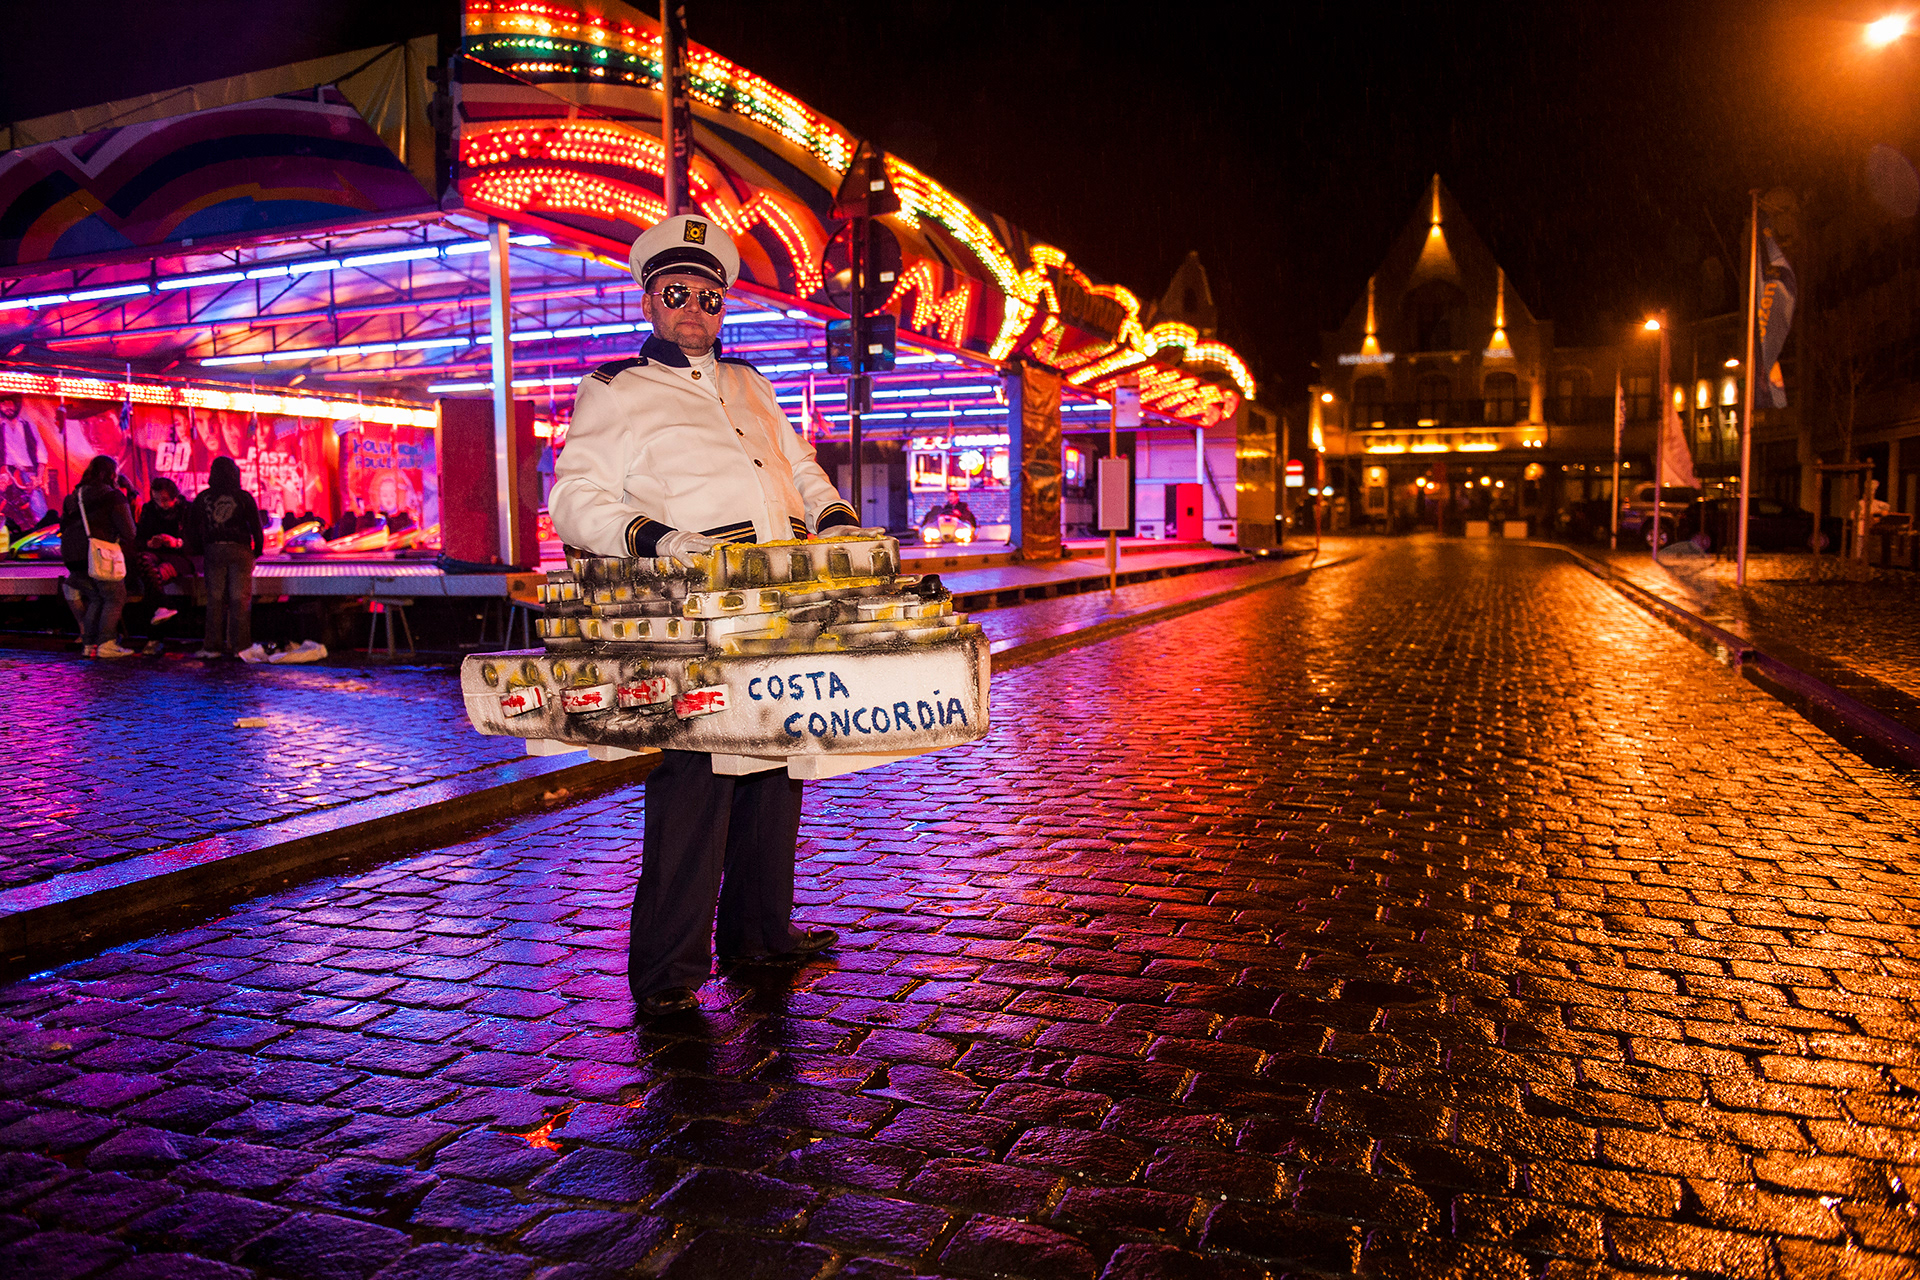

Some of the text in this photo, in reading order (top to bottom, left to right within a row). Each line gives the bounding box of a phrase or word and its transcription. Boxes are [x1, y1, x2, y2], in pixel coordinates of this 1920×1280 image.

[155, 441, 192, 472] 60
[247, 446, 288, 464] FAST
[748, 671, 850, 700] COSTA
